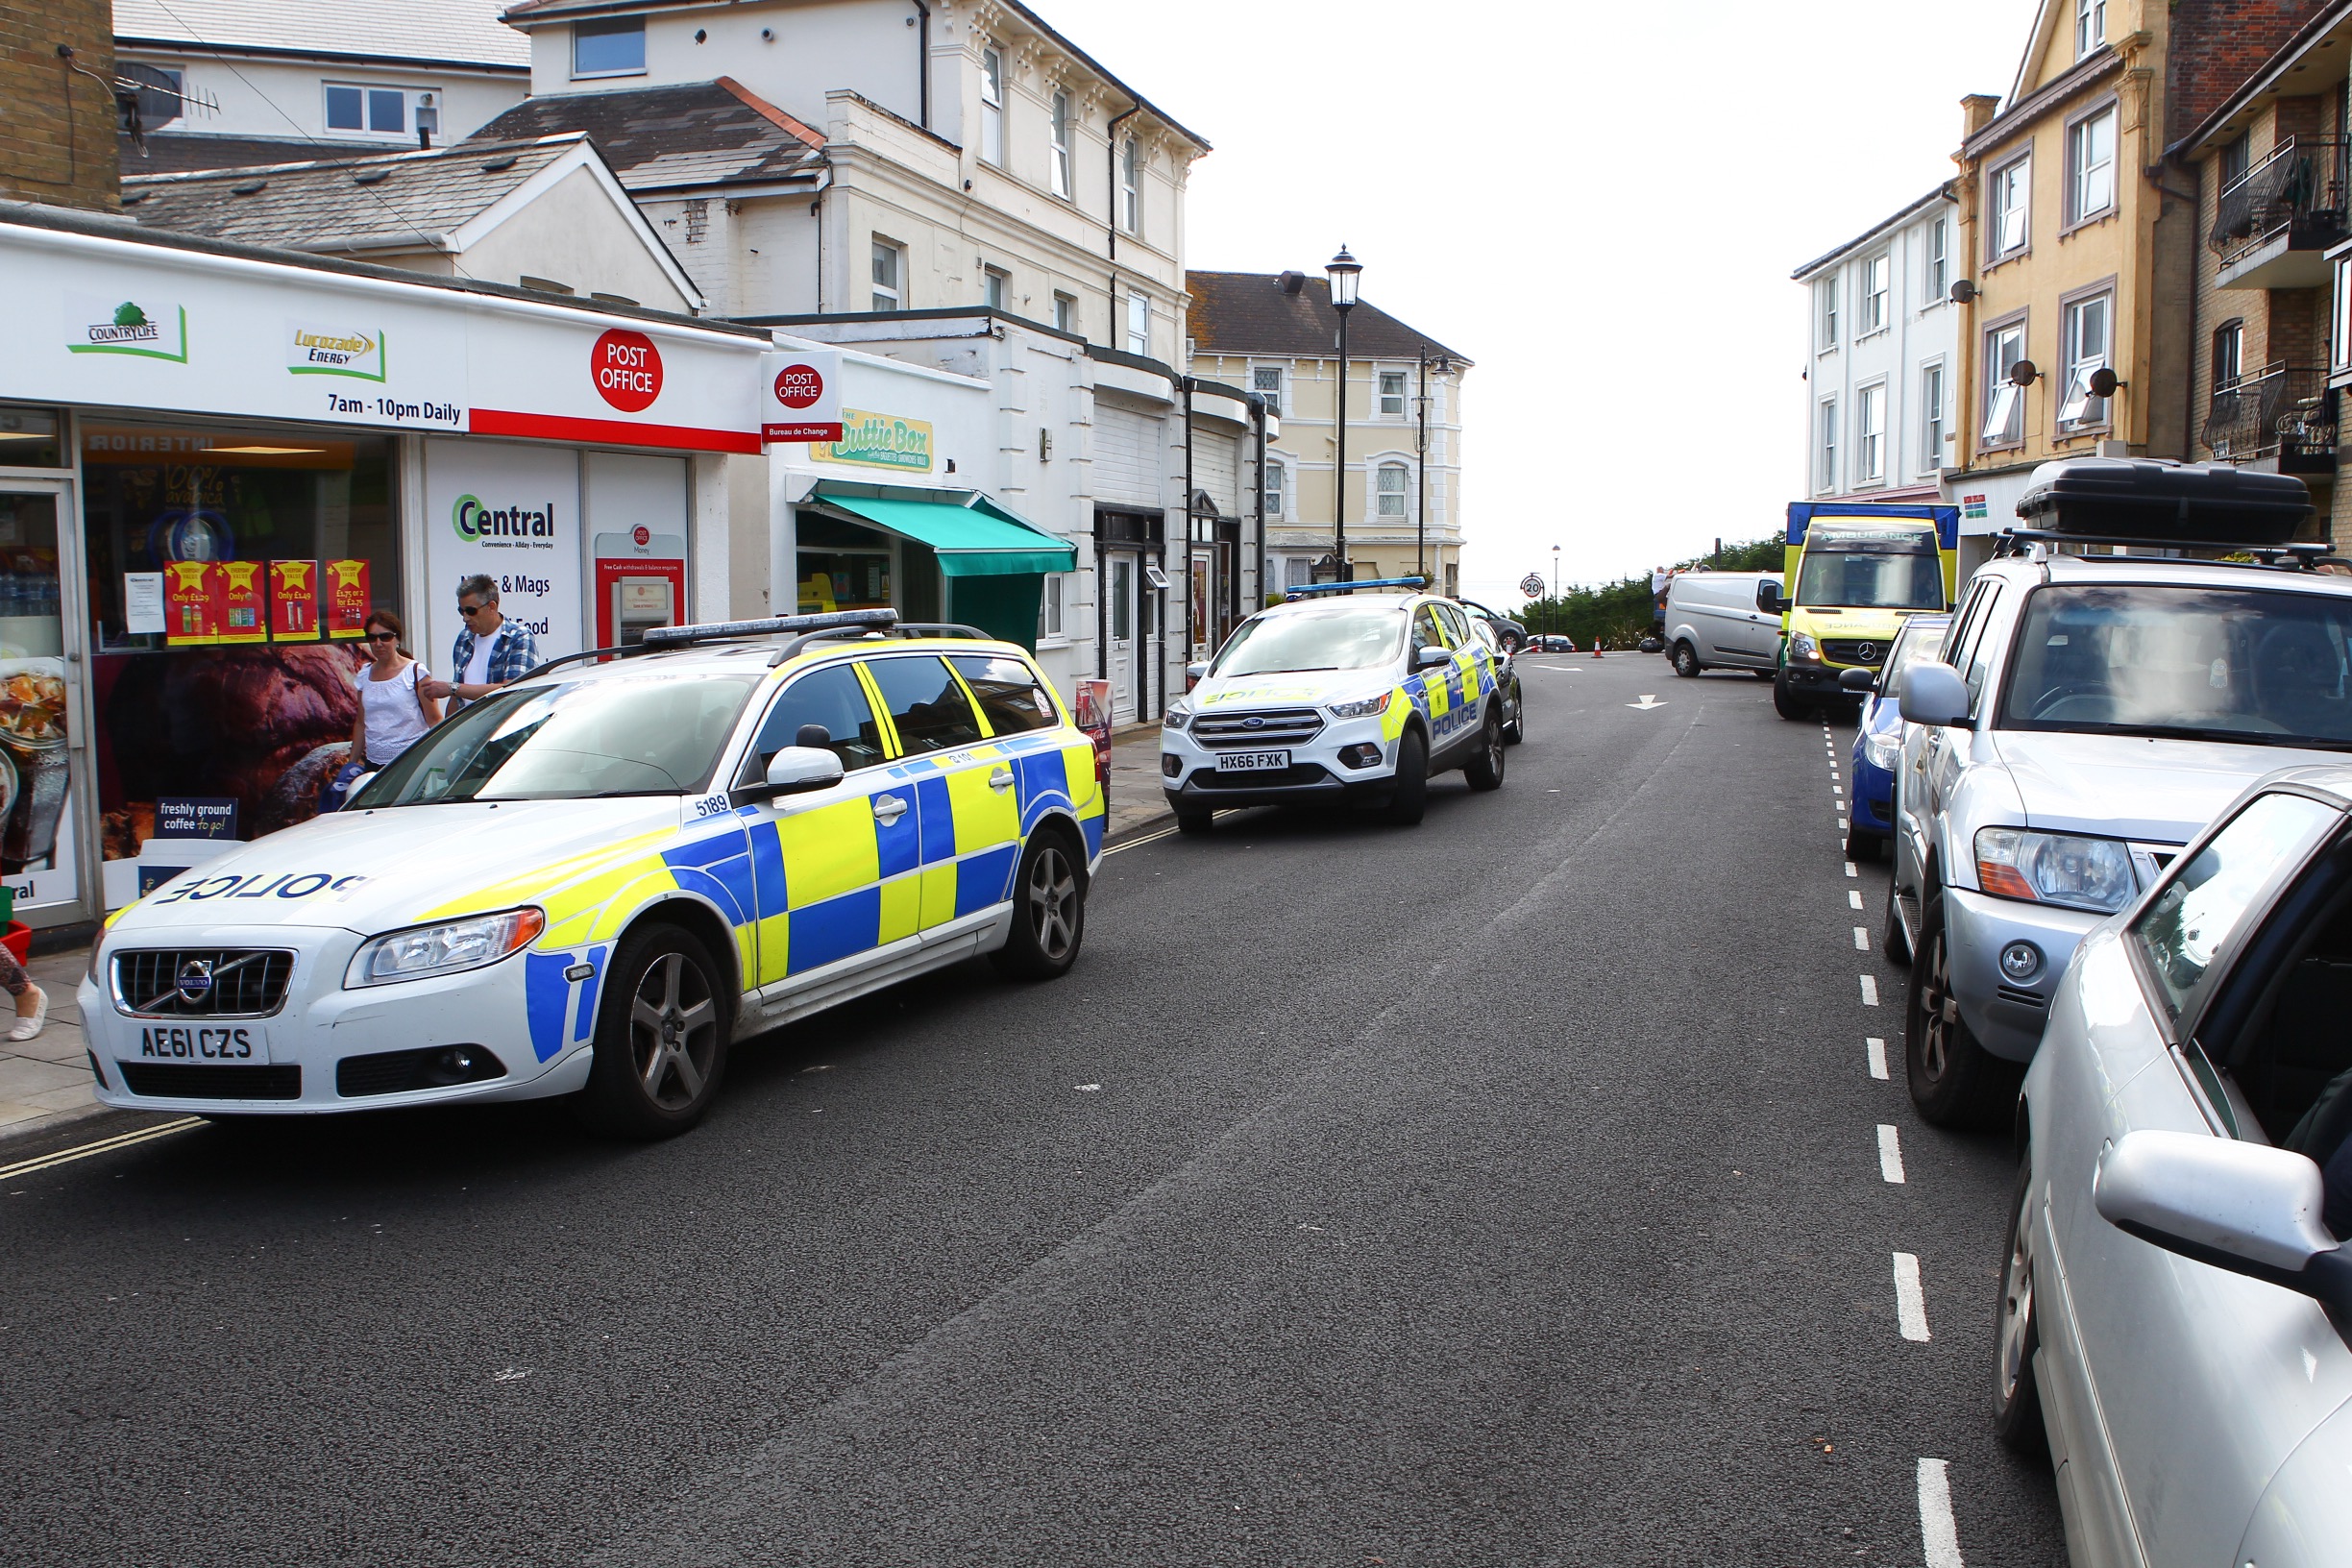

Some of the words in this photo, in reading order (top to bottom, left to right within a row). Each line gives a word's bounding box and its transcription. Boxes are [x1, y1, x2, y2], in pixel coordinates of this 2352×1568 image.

[295, 330, 363, 353] Lucozade
[607, 343, 648, 368] POST
[600, 367, 653, 393] OFFICE
[785, 373, 814, 385] POST
[778, 385, 818, 397] OFFICE
[328, 393, 363, 413] 7am
[377, 398, 420, 422] 10pm
[424, 402, 461, 426] Daily
[842, 410, 855, 420] THE
[802, 428, 828, 438] Change
[837, 419, 893, 455] Buttie
[894, 420, 927, 454] Box
[459, 501, 553, 536] Central
[1821, 531, 1923, 543] AMBULANCE
[515, 541, 530, 550] Allday
[634, 547, 650, 555] Money
[515, 575, 551, 597] Mags
[1526, 583, 1539, 593] 20
[173, 594, 189, 603] Only
[229, 593, 245, 602] Only
[278, 592, 293, 600] Only
[1433, 702, 1478, 740] POLICE
[1220, 754, 1255, 770] HX66
[1257, 753, 1283, 768] FXK
[160, 802, 194, 817] freshly
[197, 803, 232, 817] ground
[695, 795, 727, 817] 5189
[164, 818, 195, 830] coffee
[197, 818, 208, 830] to
[209, 817, 225, 837] go!
[142, 1028, 194, 1058] AE61
[199, 1029, 252, 1058] CZS
